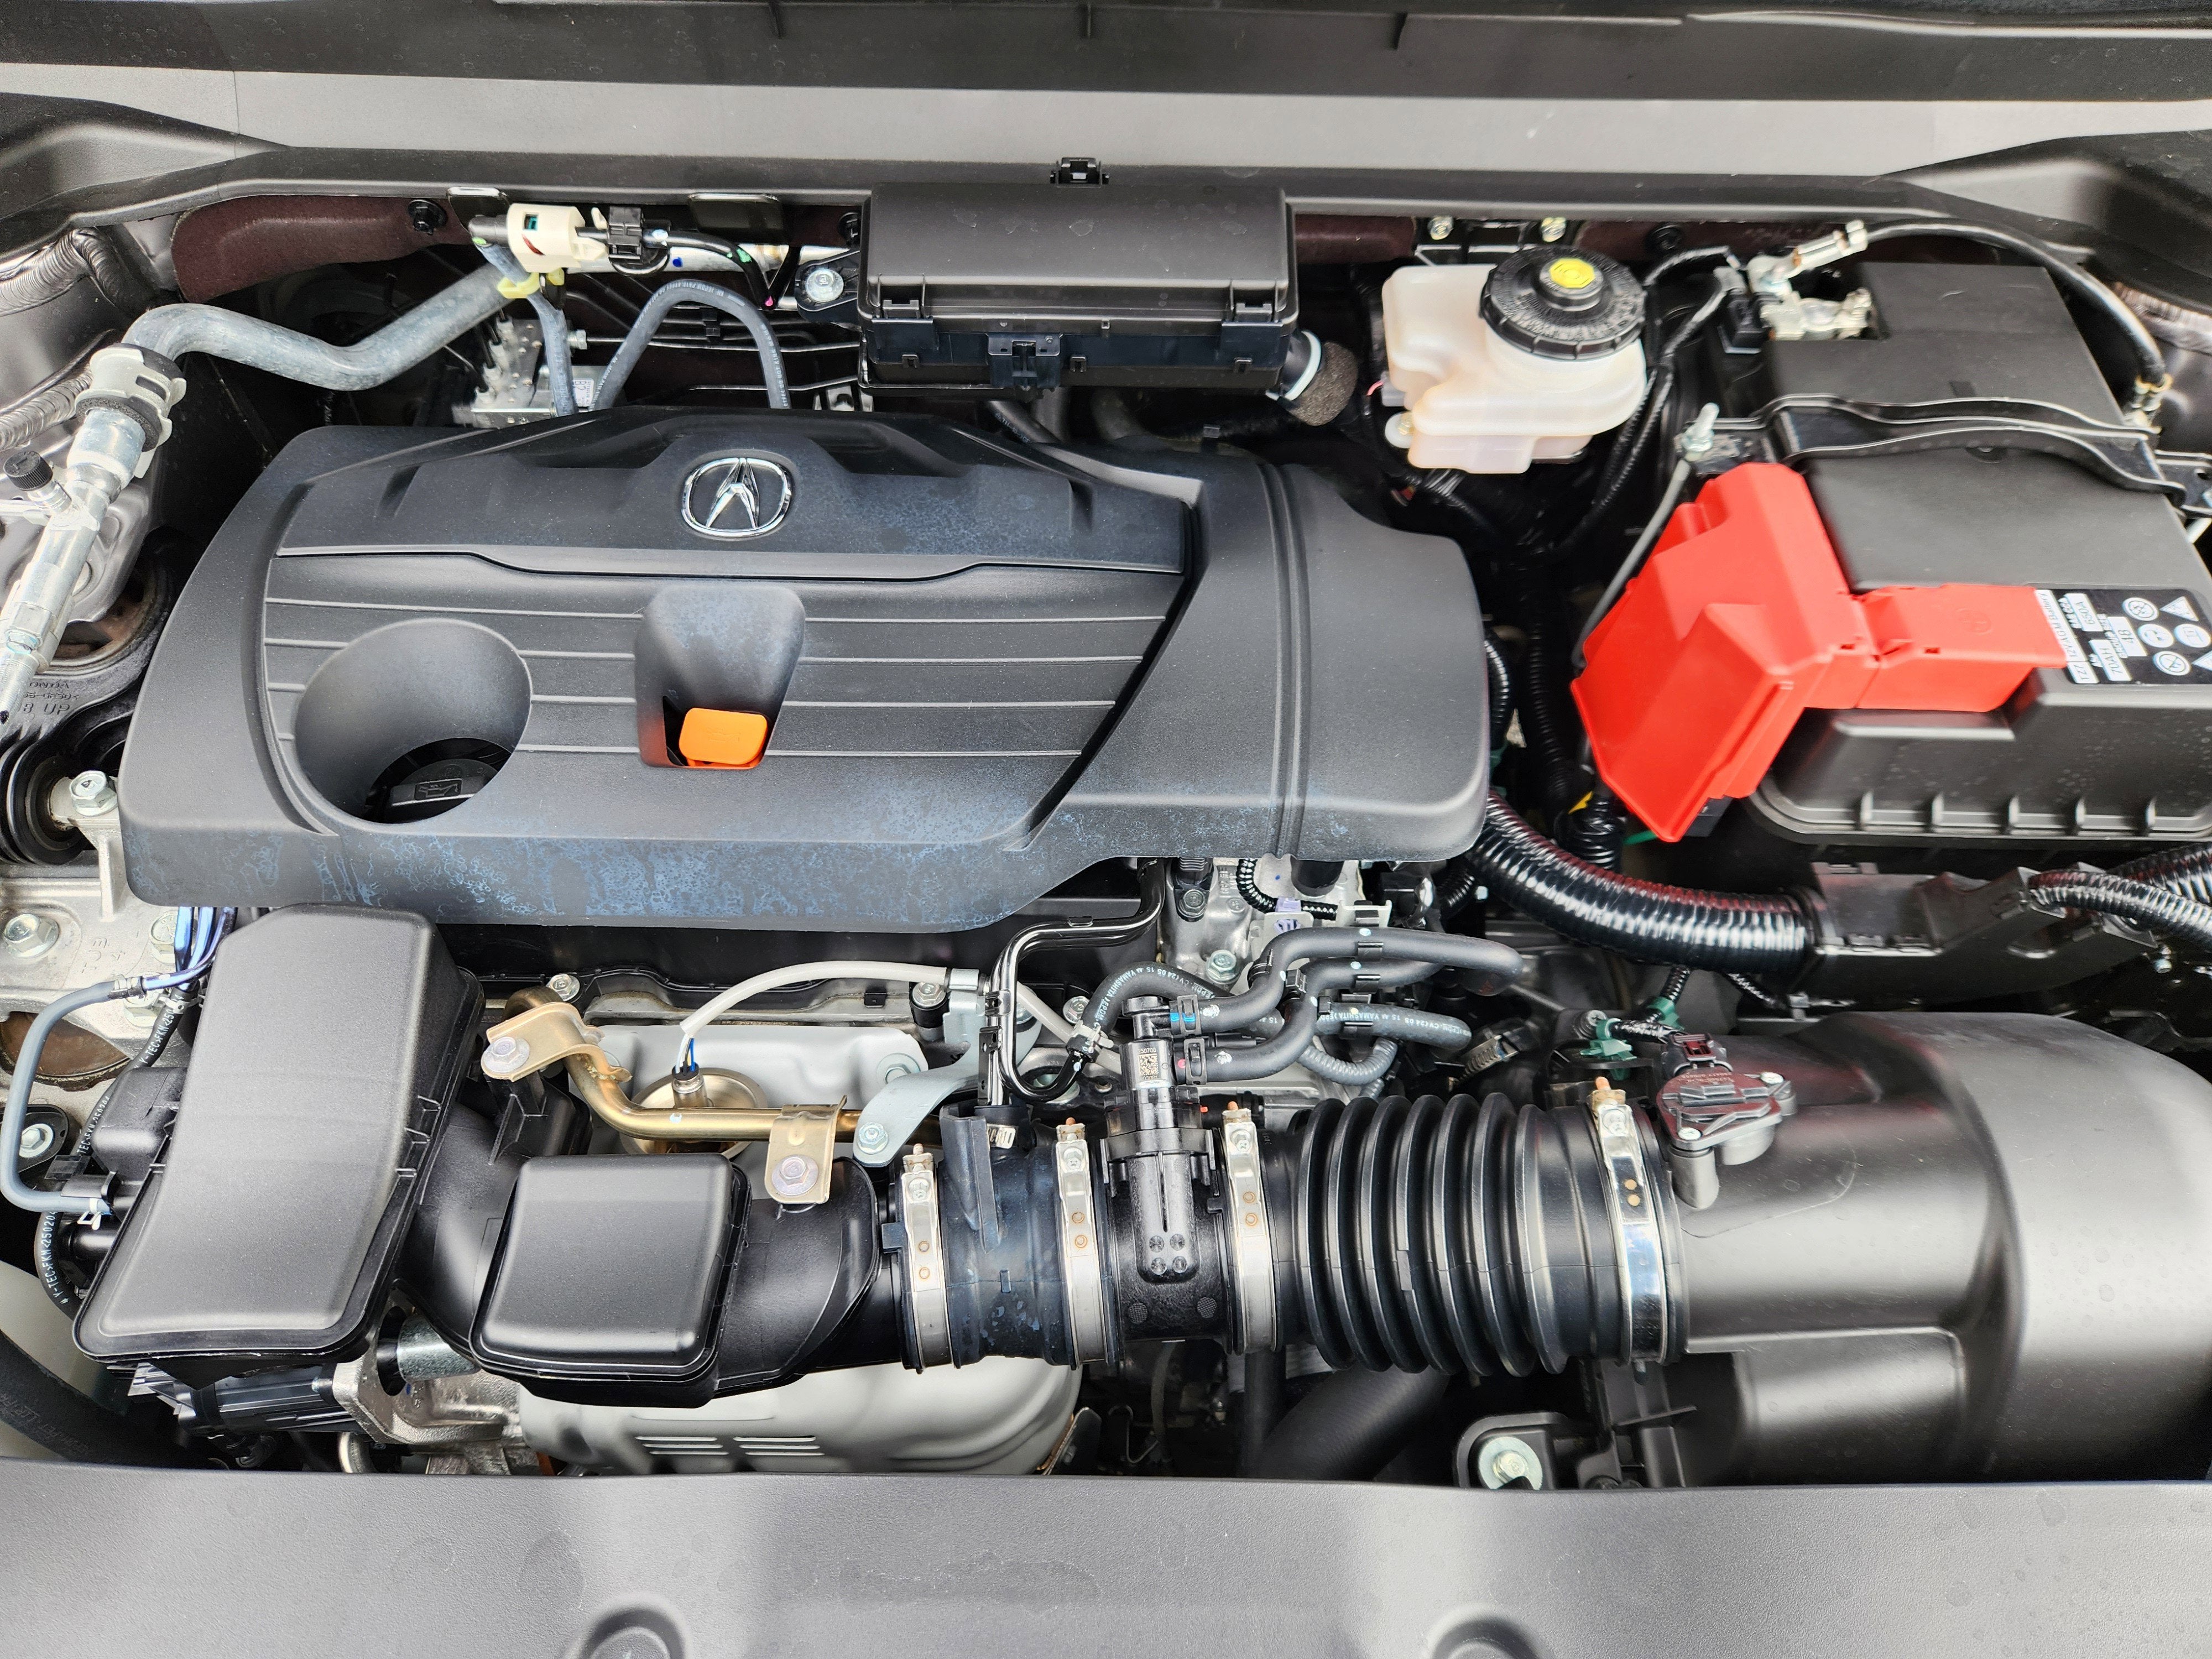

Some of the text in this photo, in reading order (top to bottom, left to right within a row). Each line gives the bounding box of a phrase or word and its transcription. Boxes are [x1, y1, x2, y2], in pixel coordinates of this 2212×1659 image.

[2038, 593, 2058, 620] Battery
[2052, 623, 2069, 642] AGM
[2075, 601, 2123, 674] 70AH 650A
[2117, 629, 2134, 644] 48
[44, 703, 70, 715] UP
[1107, 969, 1136, 997] YAMASHITA
[1338, 1011, 1379, 1020] YAMASHITA
